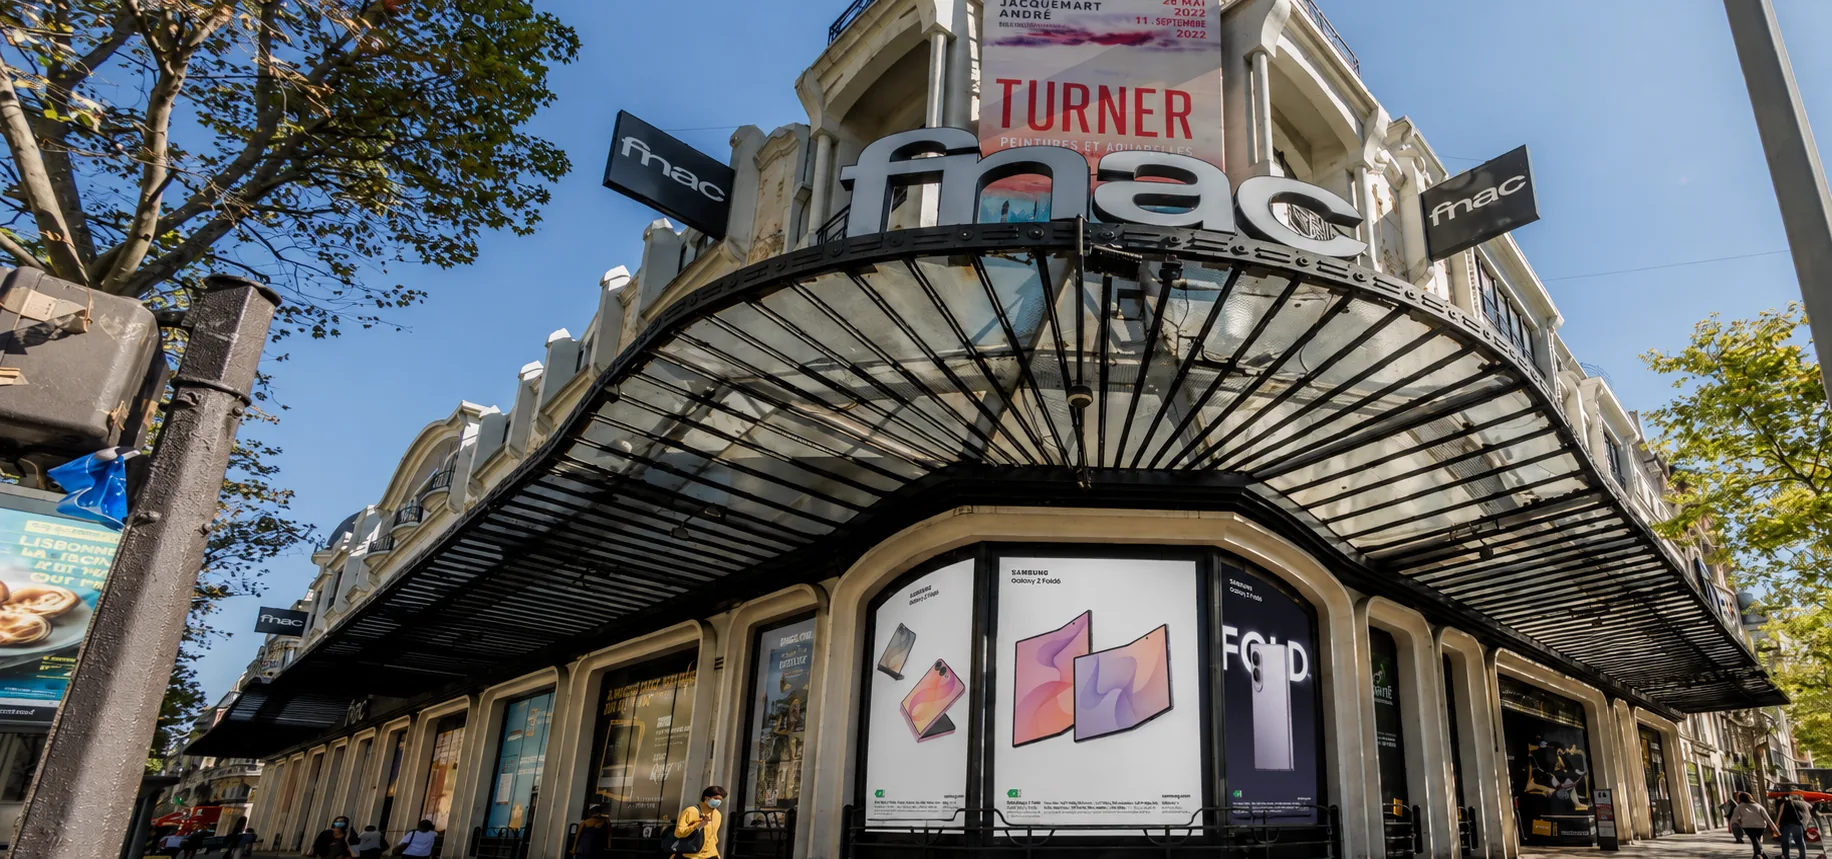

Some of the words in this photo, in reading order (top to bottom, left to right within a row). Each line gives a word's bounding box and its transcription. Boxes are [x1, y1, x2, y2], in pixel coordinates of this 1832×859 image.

[1000, 0, 1102, 11] JACQUEMART
[999, 9, 1051, 20] ANDRÉ
[1174, 8, 1206, 17] 2022
[1176, 29, 1207, 39] 2022
[996, 78, 1193, 140] TURNER
[1085, 140, 1099, 152] ET
[621, 136, 725, 202] fnac
[840, 126, 1368, 258] fnac
[1429, 174, 1526, 227] fnac
[260, 614, 304, 627] fnac
[1222, 624, 1309, 682] FOD
